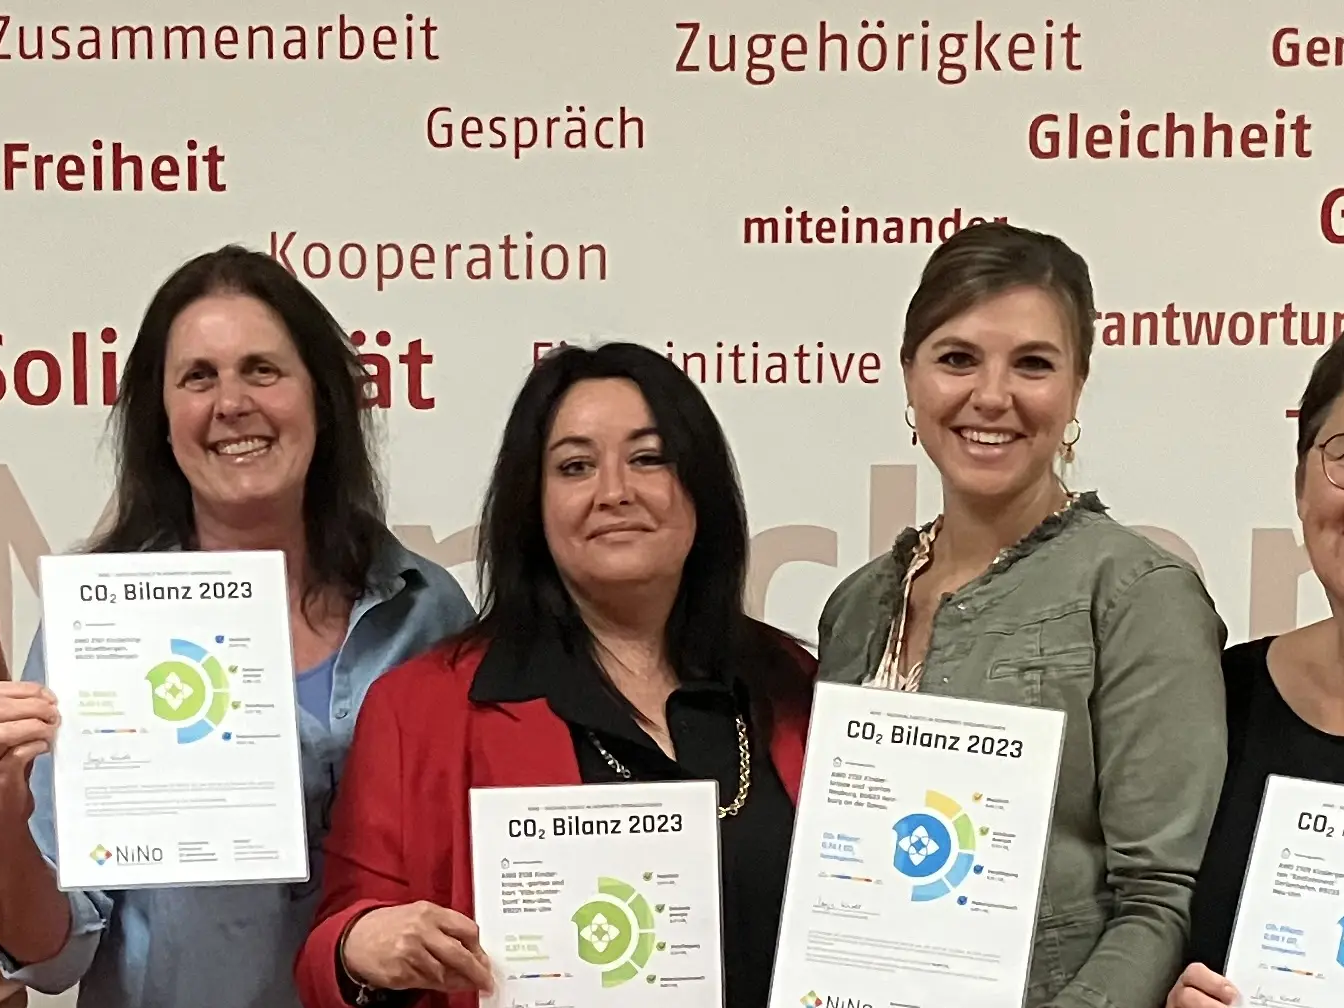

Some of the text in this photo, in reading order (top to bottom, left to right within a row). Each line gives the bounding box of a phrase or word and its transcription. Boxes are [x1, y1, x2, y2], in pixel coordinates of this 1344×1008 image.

[675, 19, 1082, 86] Zugehörigkeit
[427, 105, 644, 160] Gespräch
[1028, 108, 1313, 160] Gleichheit
[3, 138, 227, 193] Freiheit
[744, 205, 1007, 244] miteinand
[268, 230, 607, 292] Kooperation
[123, 581, 193, 601] Bilanz
[199, 581, 253, 600] 2023
[890, 725, 961, 751] Bilanz
[966, 734, 1024, 759] 2023
[552, 815, 622, 836] Bilanz
[628, 813, 683, 834] 2023
[116, 845, 163, 863] NiNo
